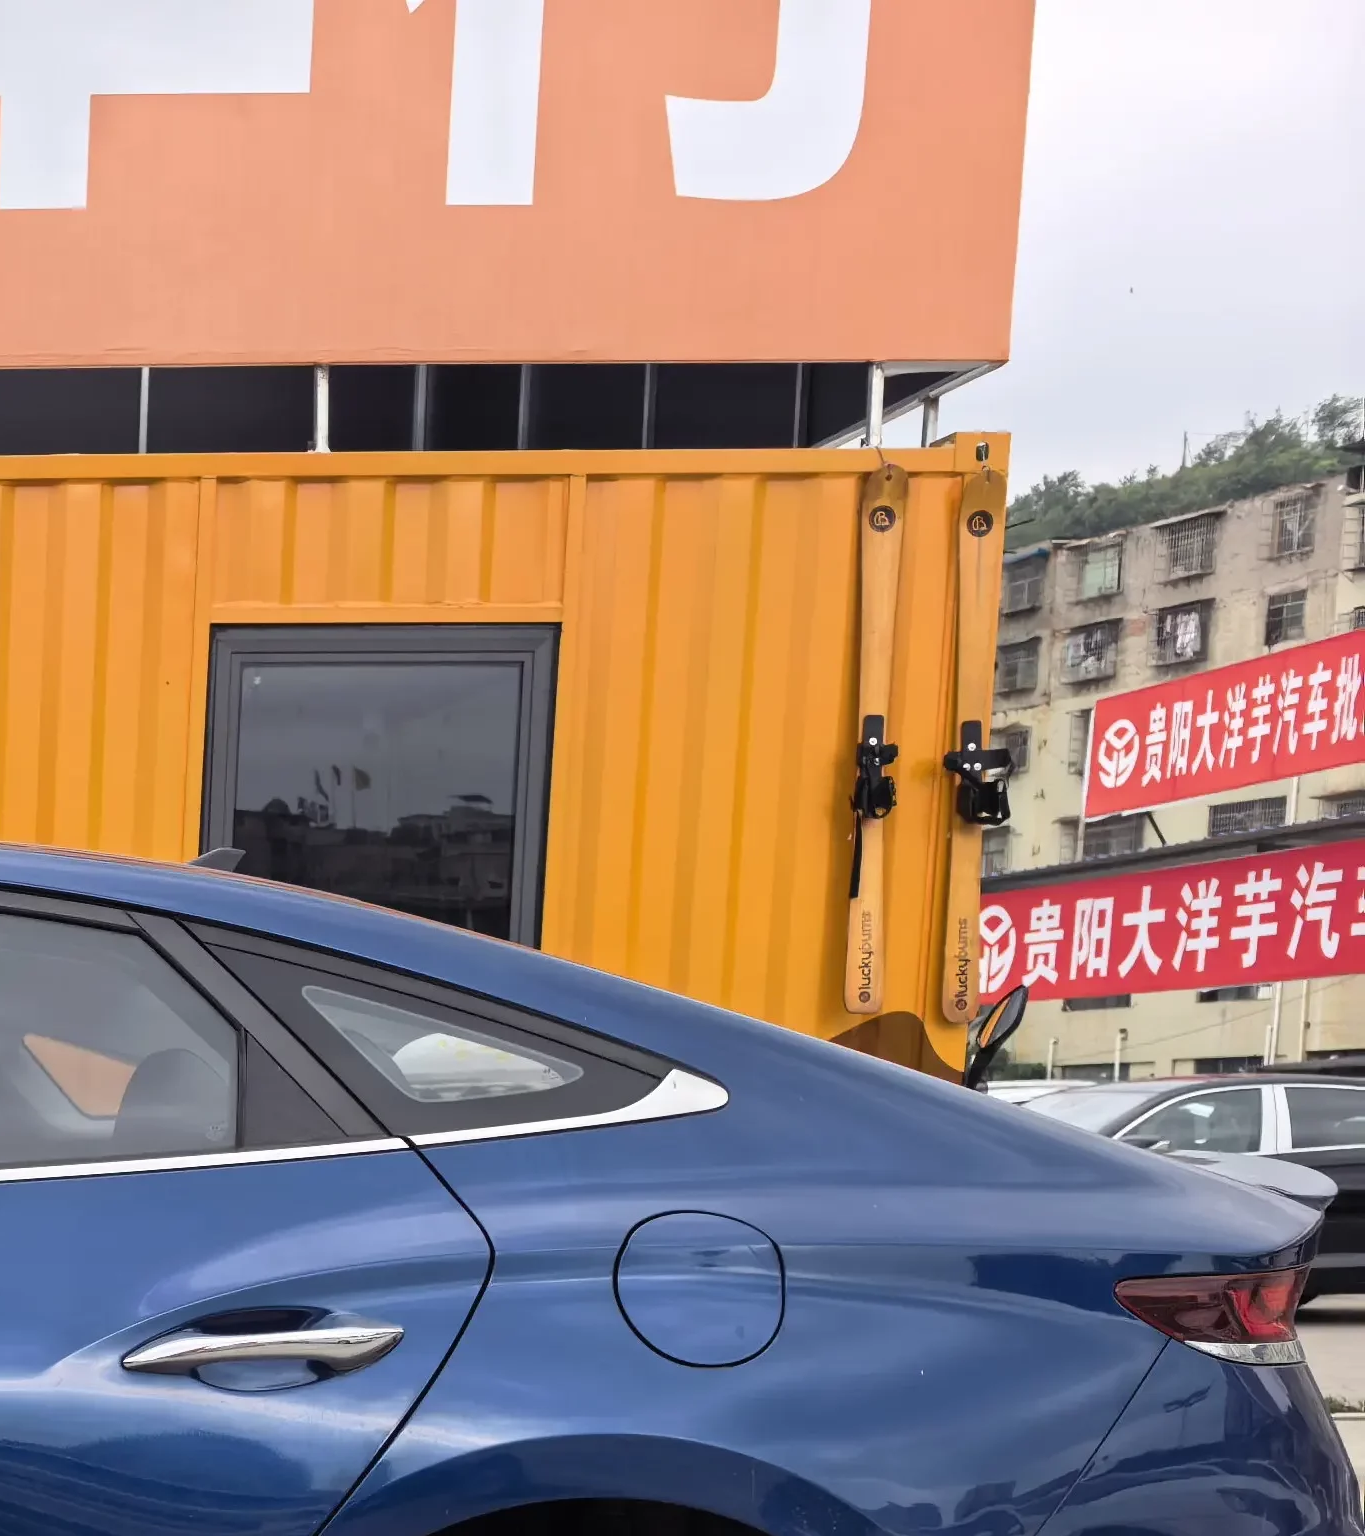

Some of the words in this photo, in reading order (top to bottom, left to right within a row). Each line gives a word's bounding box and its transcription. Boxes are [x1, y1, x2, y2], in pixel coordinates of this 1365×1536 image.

[1141, 653, 1365, 787] 贵阳大洋芋汽车批
[1022, 861, 1365, 987] 贵阳大洋芋汽
